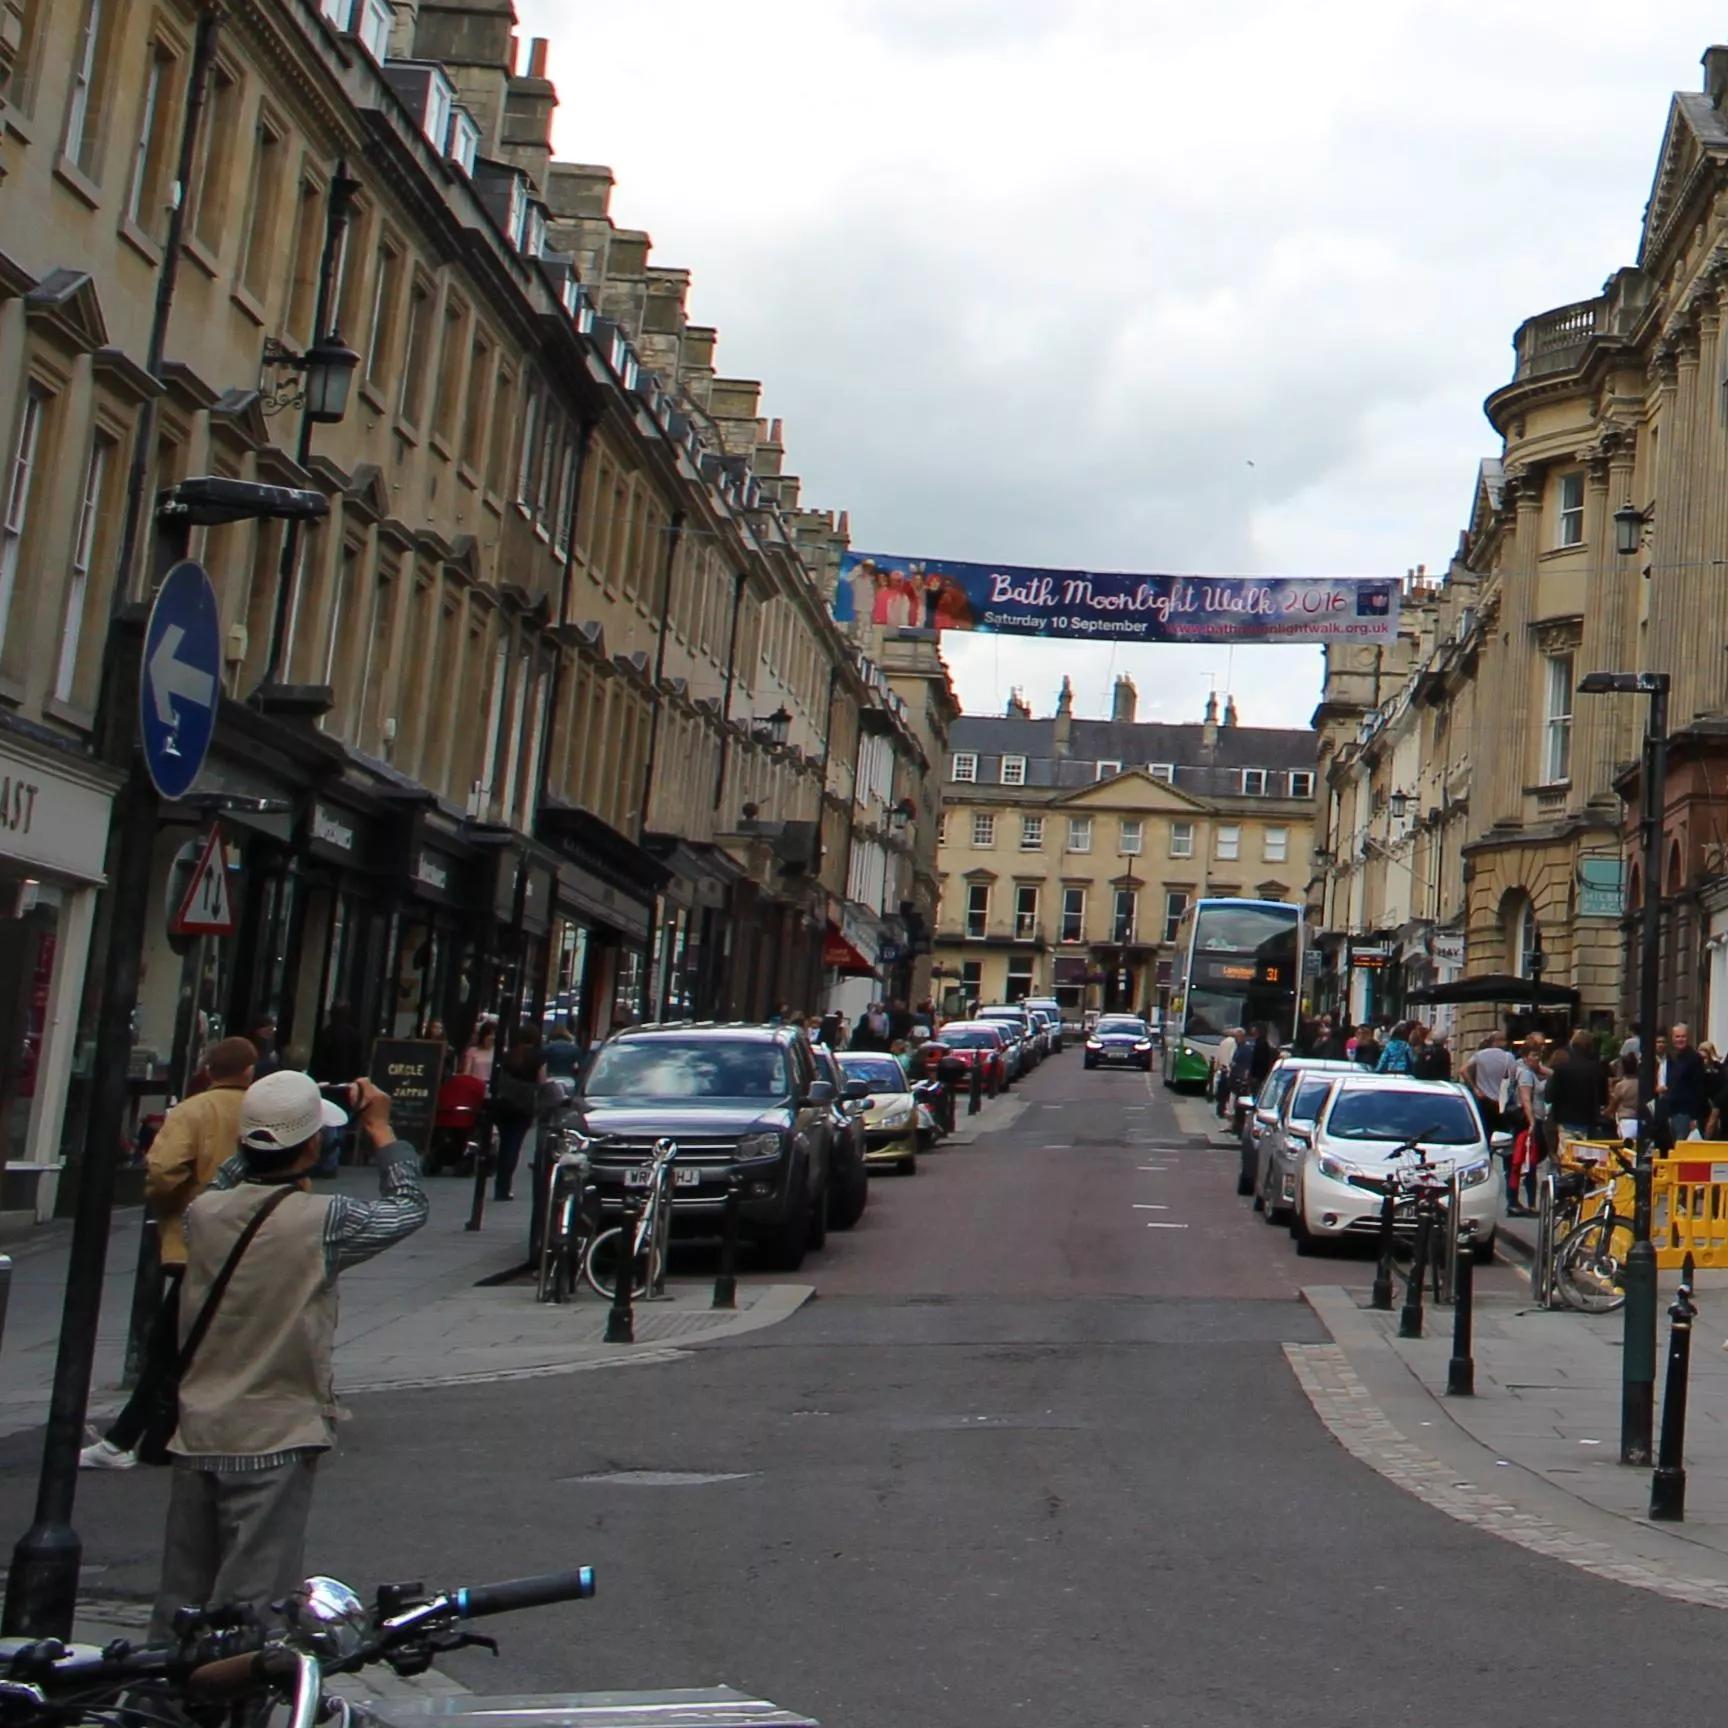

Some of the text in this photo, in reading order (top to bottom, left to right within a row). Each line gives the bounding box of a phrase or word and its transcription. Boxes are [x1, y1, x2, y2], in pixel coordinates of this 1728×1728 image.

[991, 574, 1059, 606] Bath
[1063, 579, 1198, 622] Moonlight
[1203, 585, 1275, 614] Walk
[1282, 589, 1348, 614] 2016
[984, 611, 1149, 633] Saturday 10 September
[1266, 967, 1279, 981] 31
